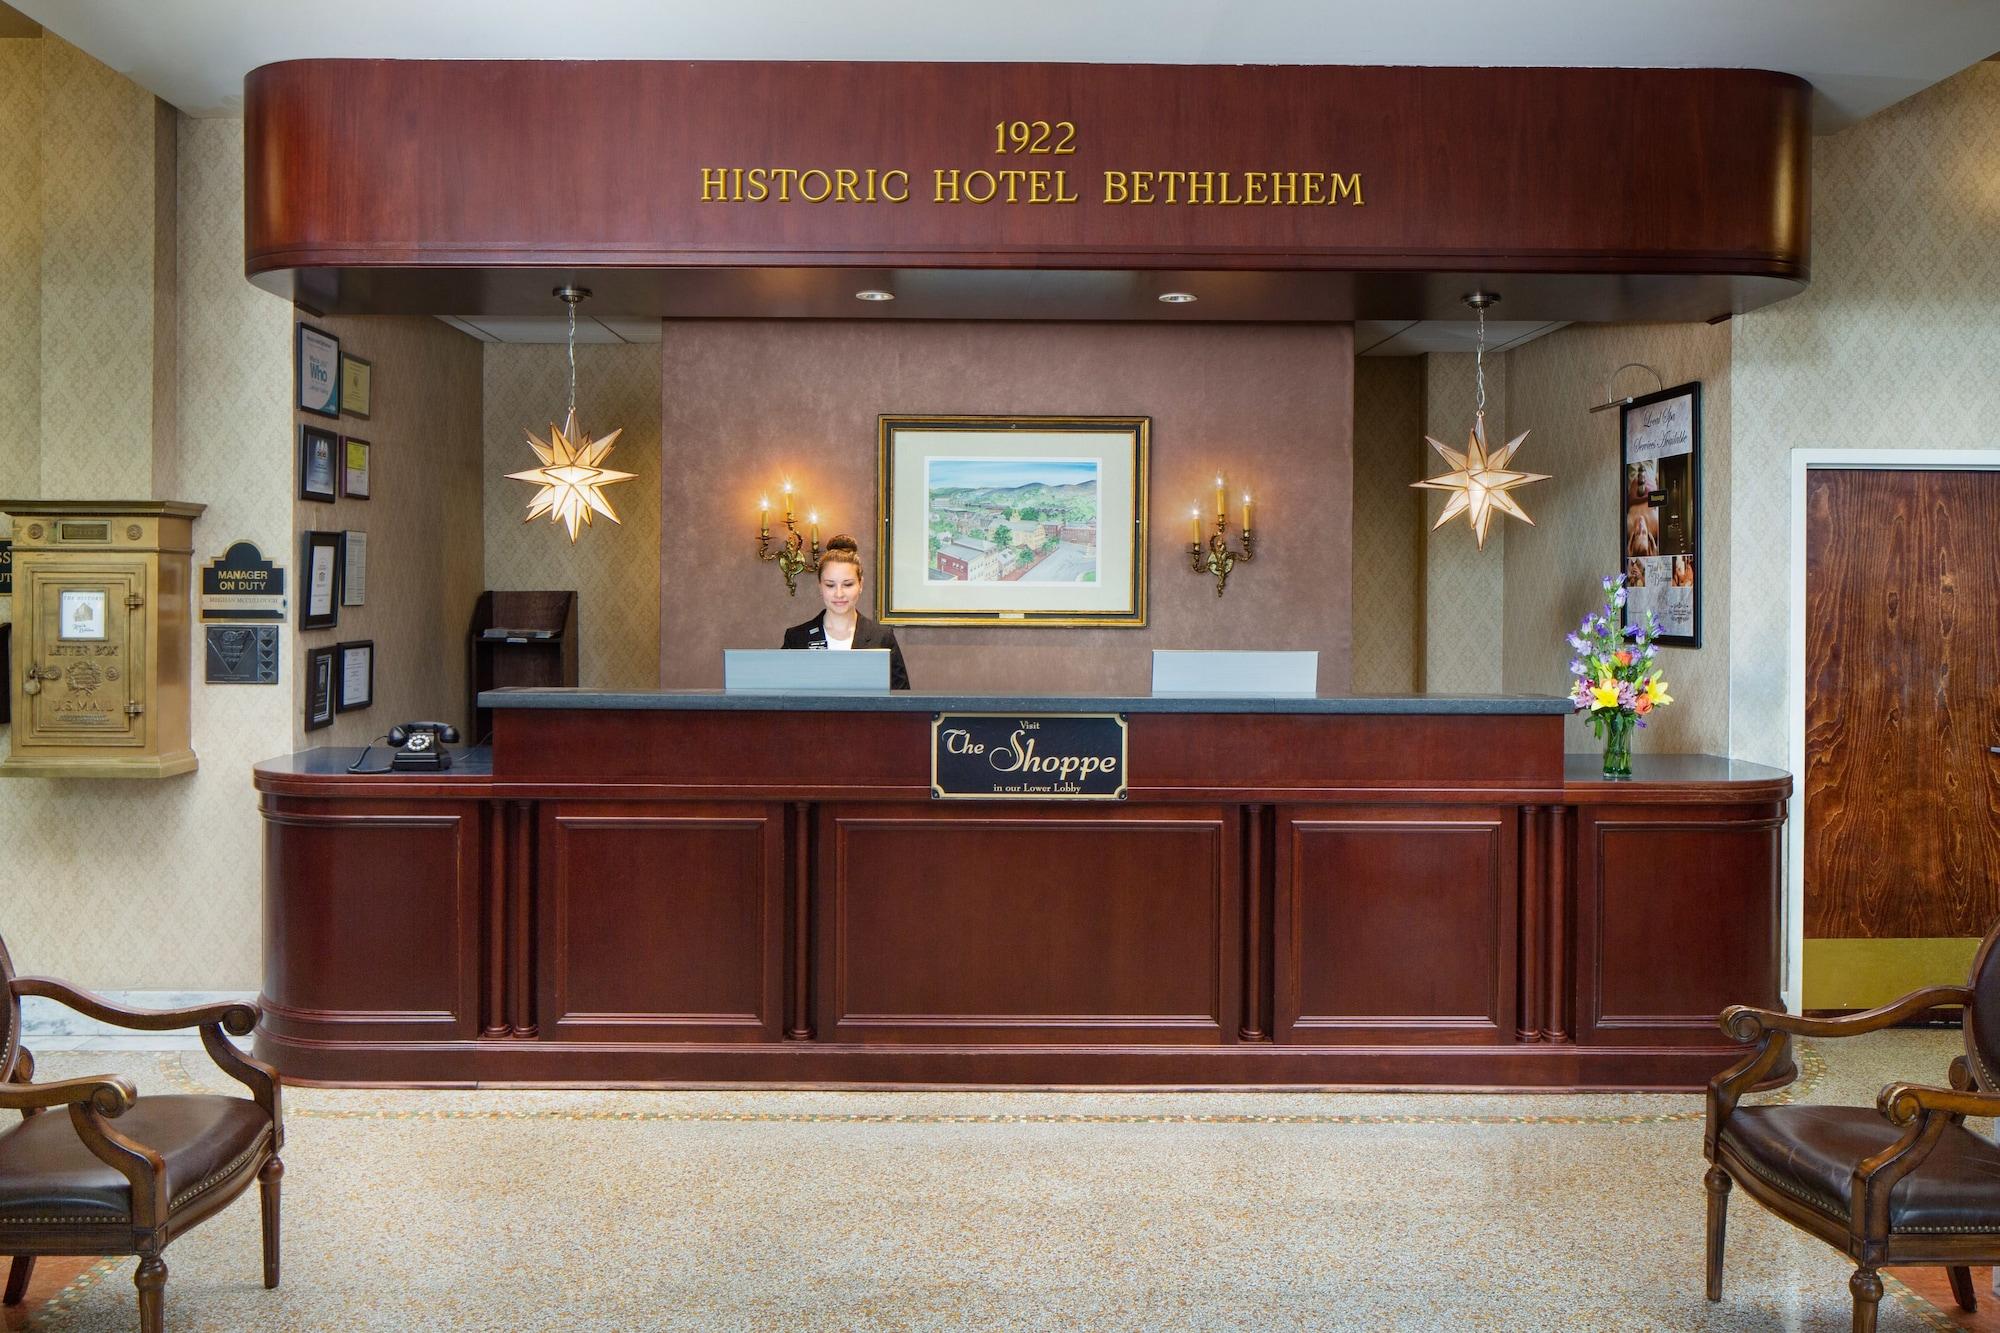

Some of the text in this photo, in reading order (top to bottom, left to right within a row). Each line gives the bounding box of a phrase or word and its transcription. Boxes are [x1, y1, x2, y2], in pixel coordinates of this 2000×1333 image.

[995, 120, 1077, 154] 1922
[700, 168, 1365, 206] HISTORIC HOTEL BETHLEHEM
[218, 570, 268, 580] MANAGER
[219, 581, 267, 591] ON DUTY
[48, 645, 119, 657] LETTER BOX
[1019, 720, 1040, 730] Visit
[942, 729, 1117, 781] The Shoppe
[993, 783, 1082, 794] in our Lower Lobby
